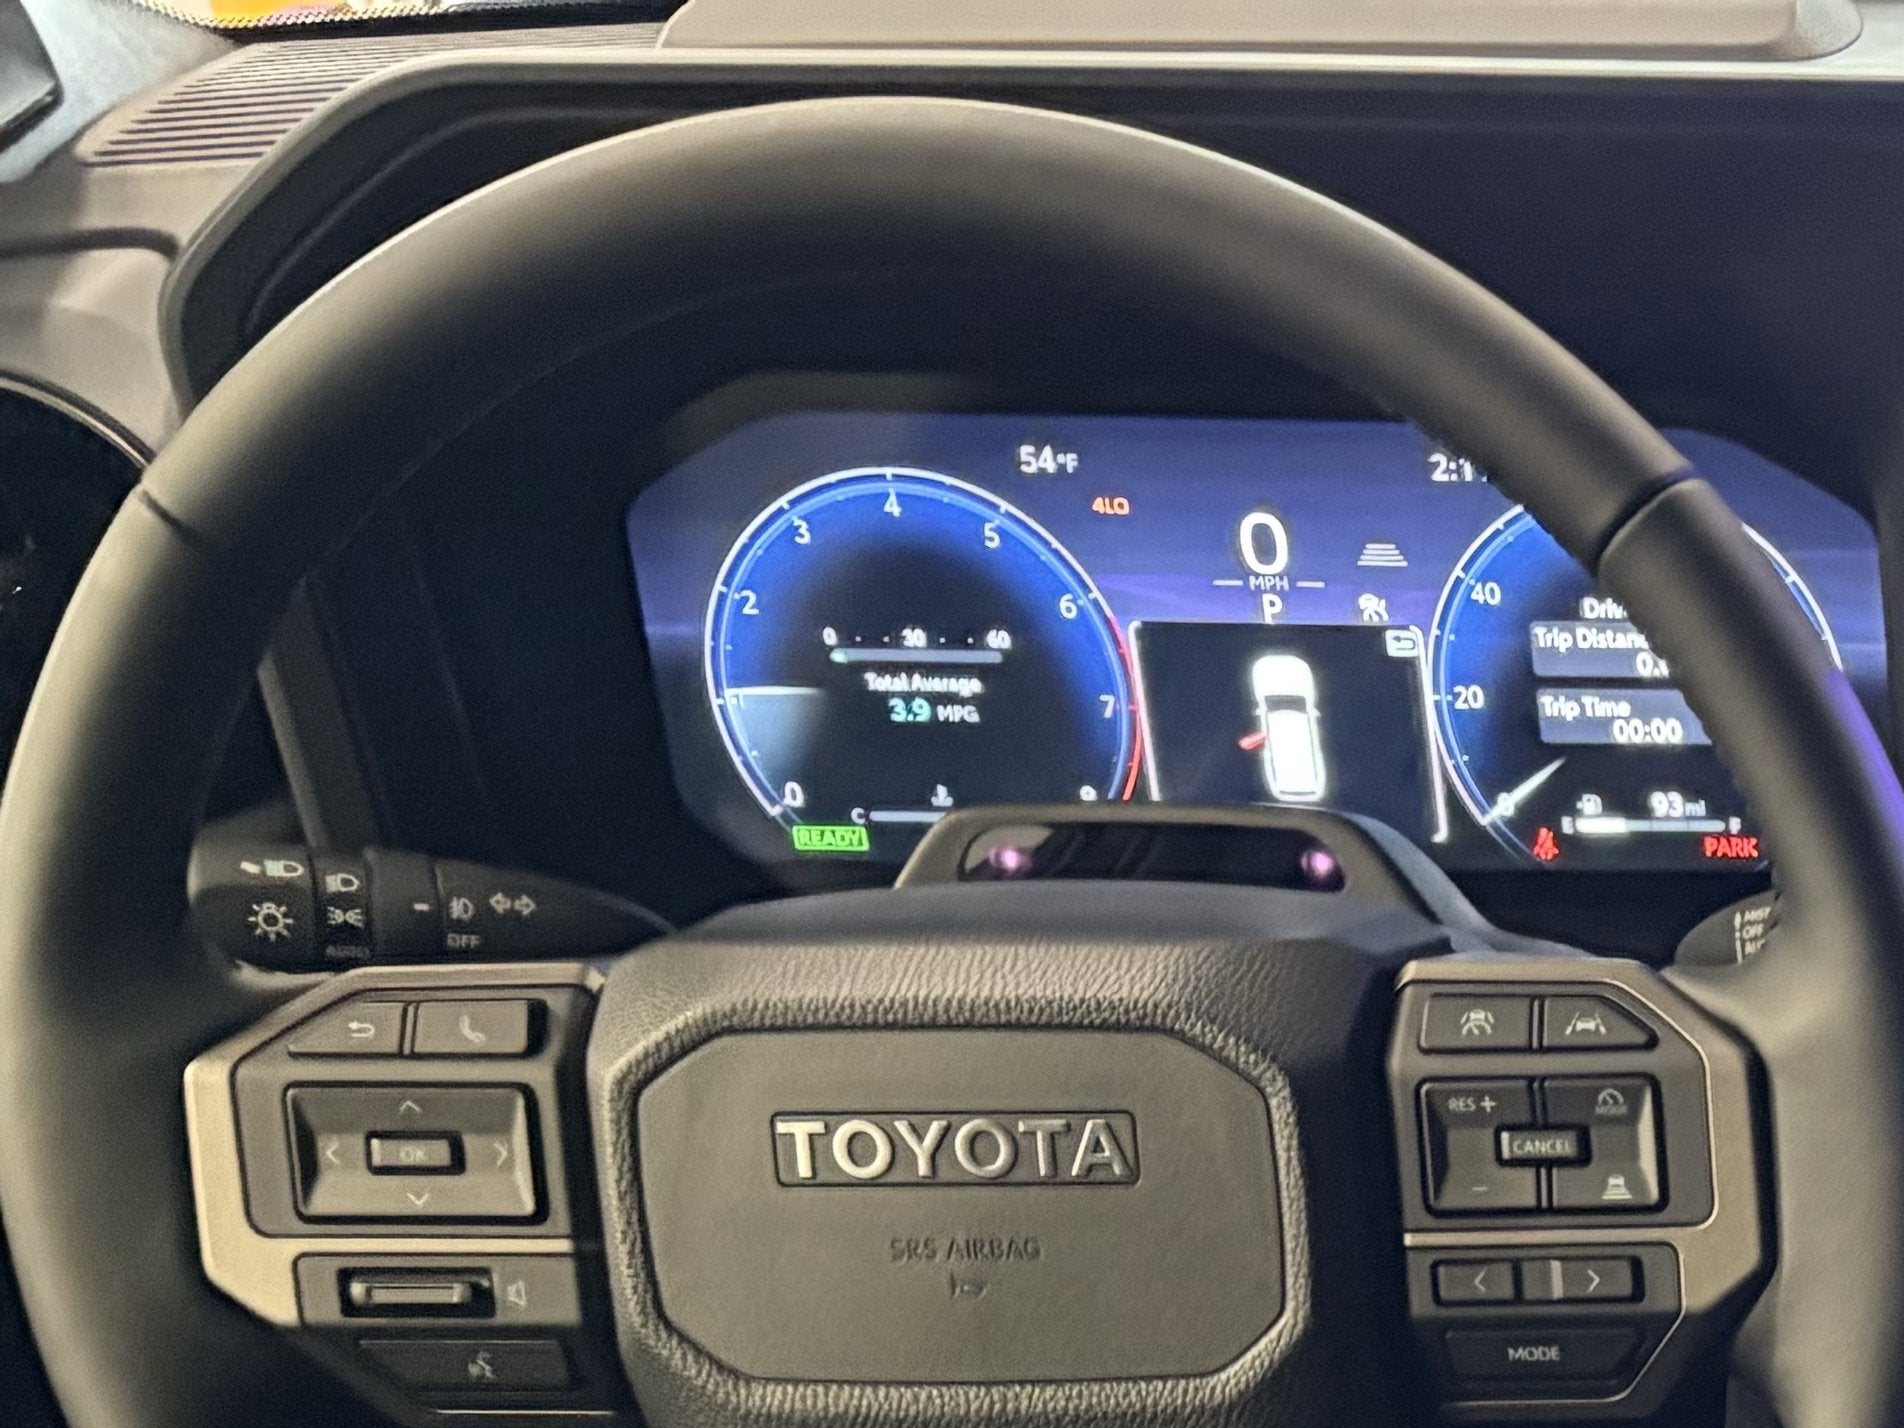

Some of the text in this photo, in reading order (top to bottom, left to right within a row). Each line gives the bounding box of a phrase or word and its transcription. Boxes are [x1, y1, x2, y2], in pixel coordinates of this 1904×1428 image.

[883, 493, 901, 517] 4
[1092, 497, 1130, 515] 4LO
[794, 522, 811, 545] 3
[984, 523, 1001, 548] 5
[1239, 511, 1289, 576] 0
[1249, 575, 1290, 592] MPH
[1471, 583, 1501, 605] 40
[742, 591, 760, 615] 2
[1059, 593, 1078, 619] 6
[1262, 593, 1283, 623] P
[822, 626, 838, 647] 0
[901, 627, 928, 648] 30
[1534, 627, 1574, 654] Trip
[864, 671, 984, 698] Total Average
[1100, 696, 1116, 718] 7
[1454, 687, 1484, 709] 20
[1540, 695, 1631, 721] Trip Time
[888, 697, 980, 723] 3.9 MPG
[1612, 717, 1683, 744] 00:00
[798, 828, 864, 847] READY
[1703, 835, 1759, 858] PARK
[1448, 1097, 1476, 1112] RES
[776, 1119, 1136, 1179] TOYOTA
[1512, 1138, 1573, 1156] CANCEL
[1508, 1346, 1560, 1362] MODE
